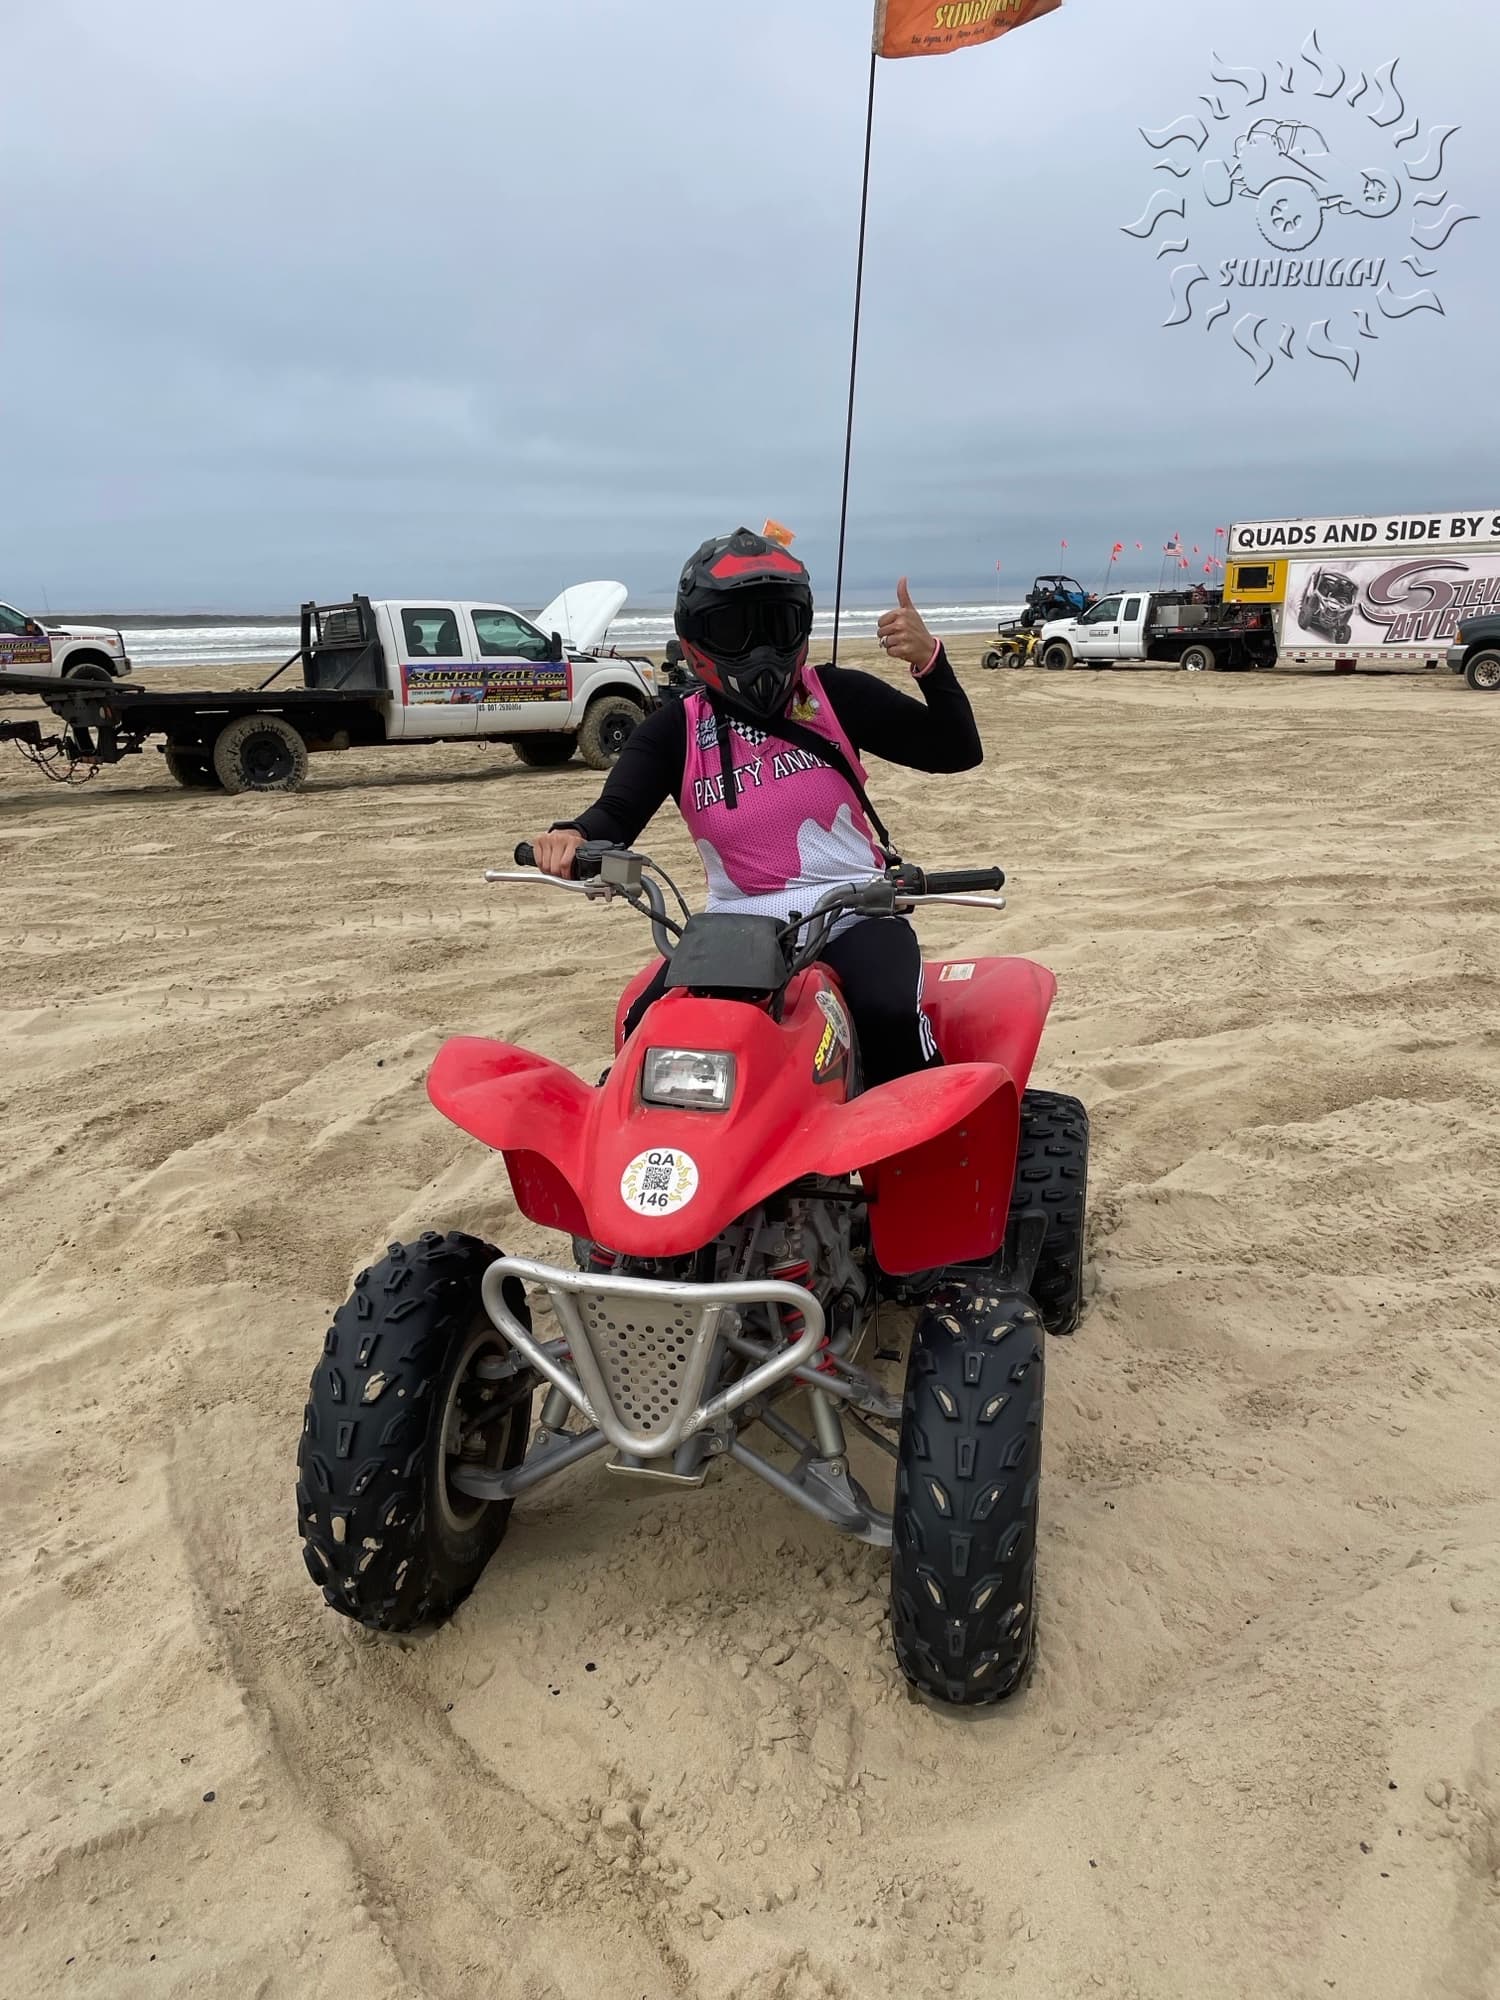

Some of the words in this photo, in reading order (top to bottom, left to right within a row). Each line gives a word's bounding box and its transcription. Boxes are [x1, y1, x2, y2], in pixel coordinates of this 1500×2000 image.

[1238, 525, 1316, 548] QUADS
[1323, 522, 1377, 544] AND
[1385, 519, 1442, 540] SIDE
[1449, 517, 1484, 538] BY
[1383, 608, 1443, 643] ATV
[772, 749, 833, 780] ANM
[648, 1152, 675, 1167] QA
[638, 1192, 669, 1207] 146
